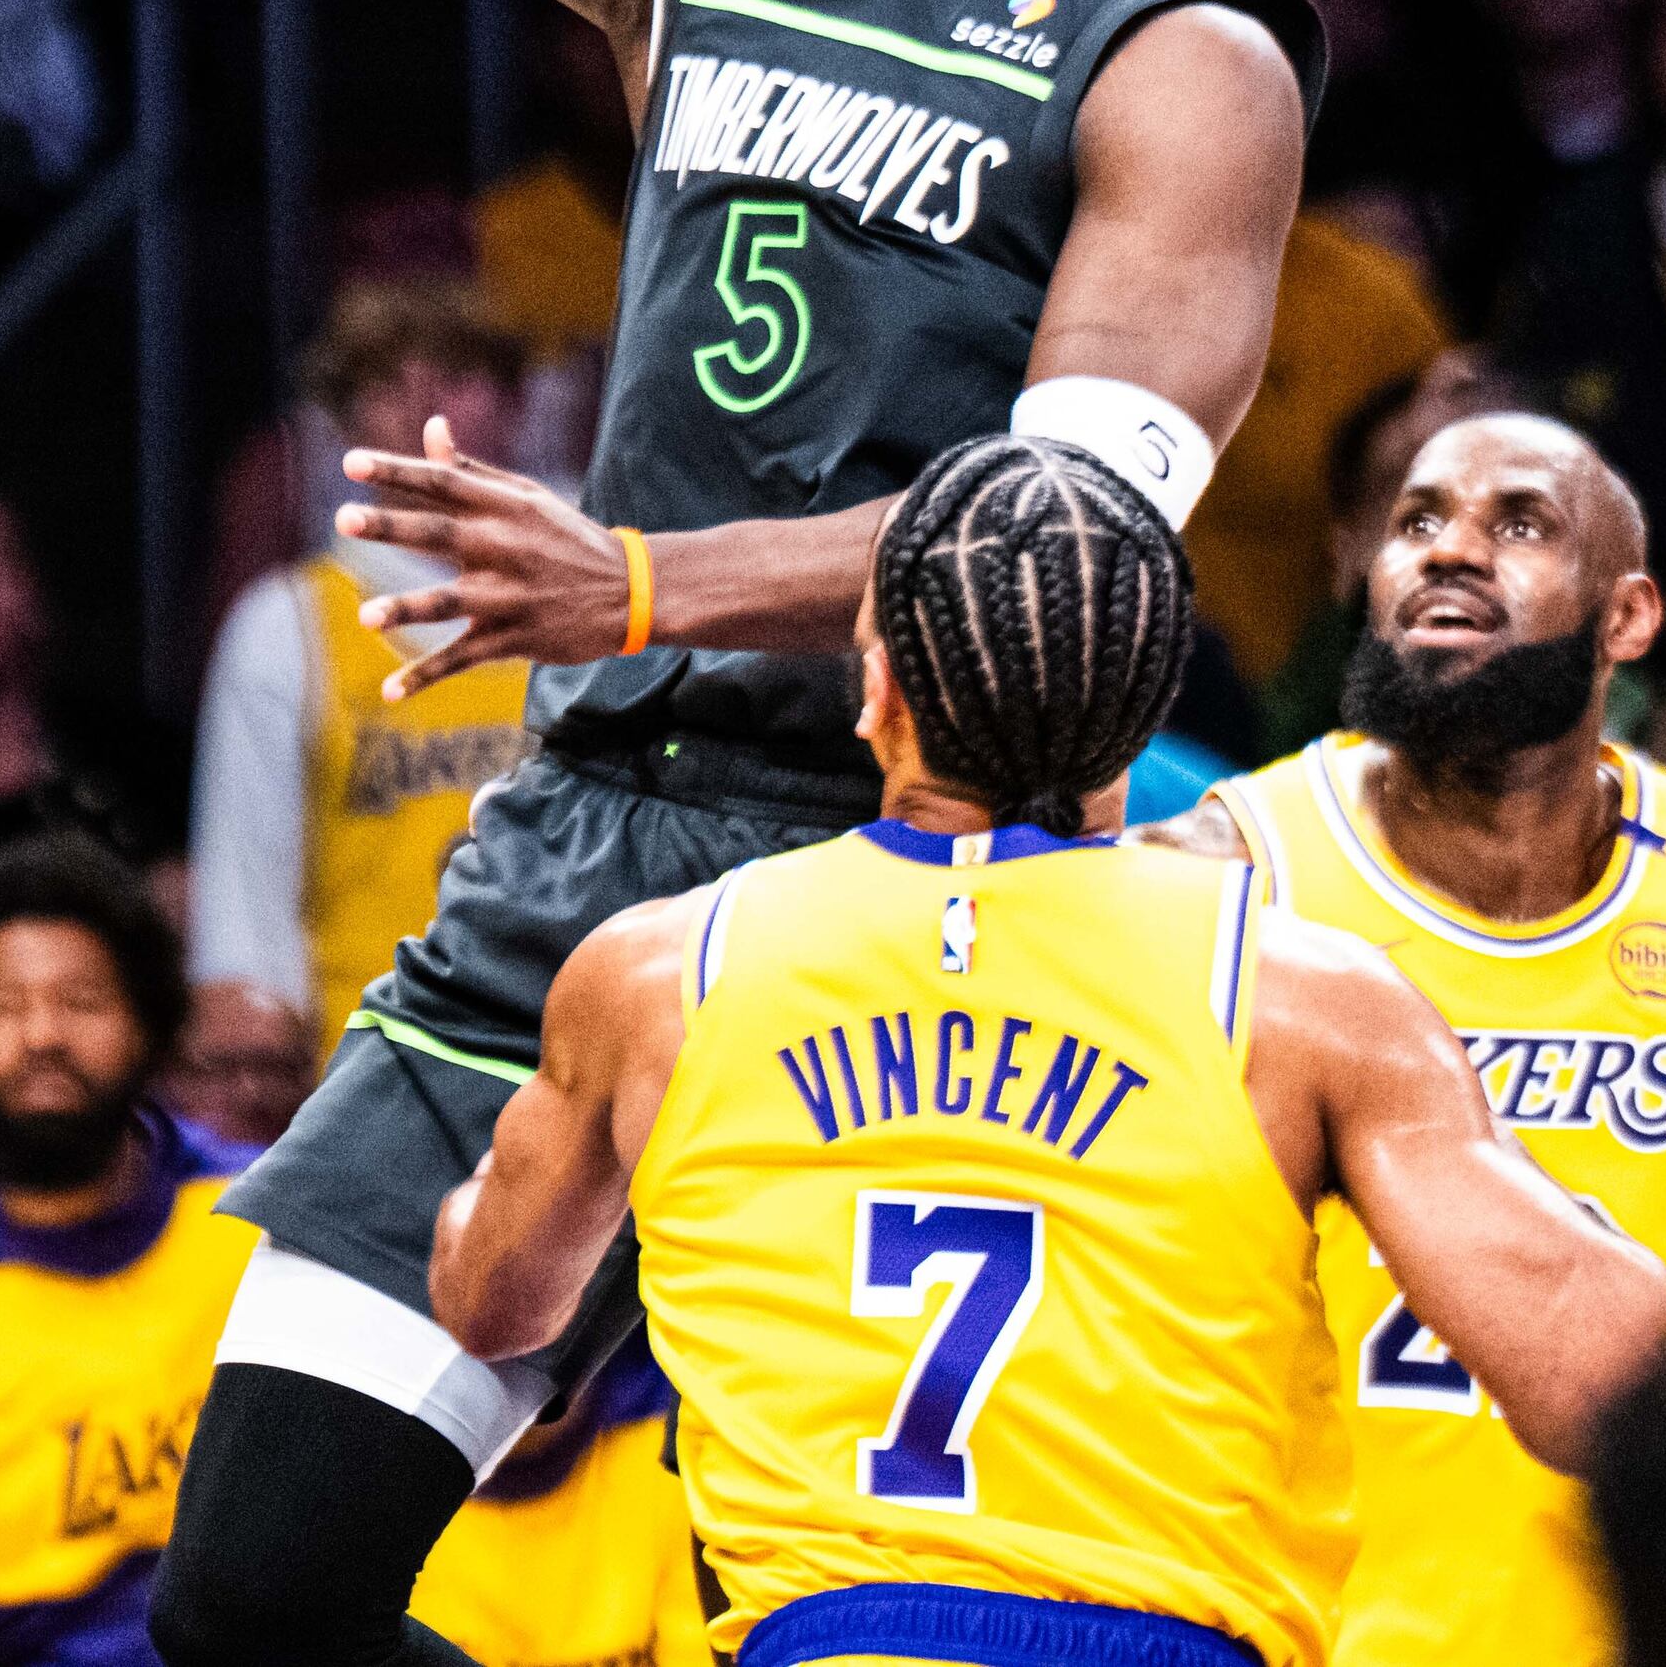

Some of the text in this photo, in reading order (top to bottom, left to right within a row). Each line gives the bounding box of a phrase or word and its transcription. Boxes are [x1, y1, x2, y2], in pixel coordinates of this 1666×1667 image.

[950, 16, 1061, 70] sezzle
[653, 53, 1010, 246] TIMBERWOLVES
[692, 200, 812, 414] 5
[1135, 419, 1181, 483] 5
[776, 1010, 1149, 1160] VINCENT
[850, 1190, 1045, 1515] 7
